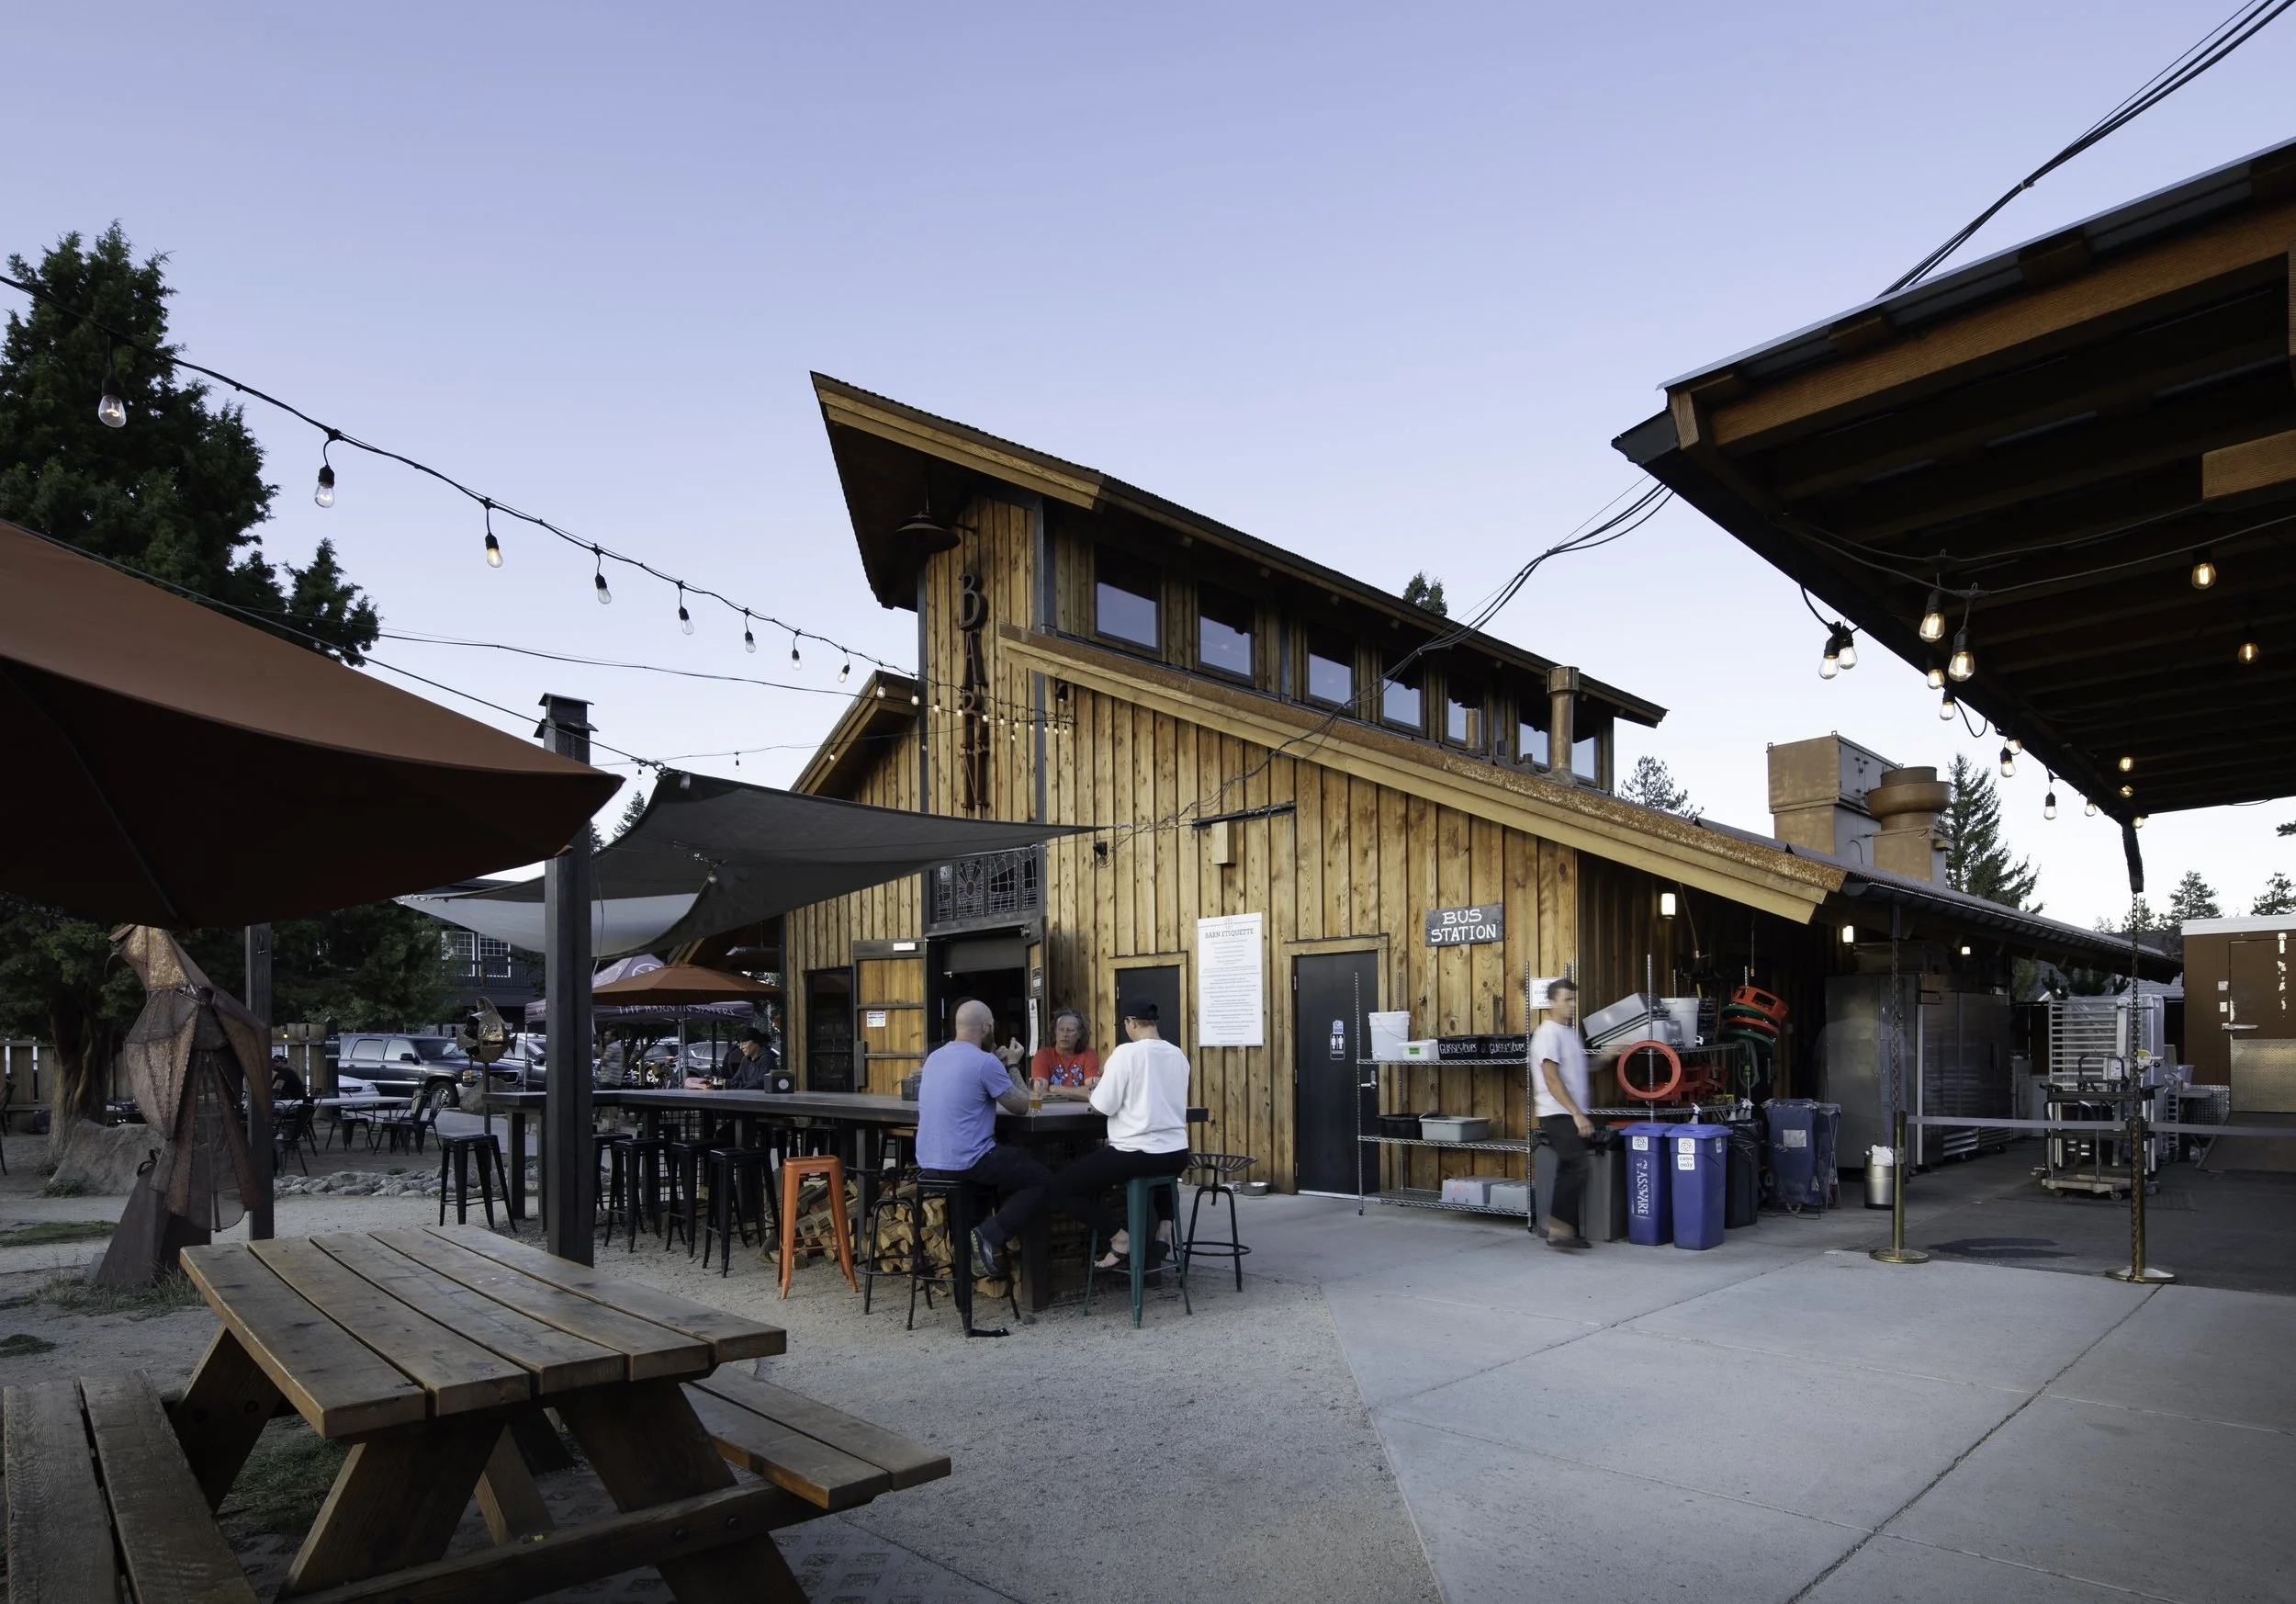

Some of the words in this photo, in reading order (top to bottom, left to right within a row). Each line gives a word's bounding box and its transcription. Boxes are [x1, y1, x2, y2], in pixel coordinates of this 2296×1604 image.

[958, 573, 989, 809] BARN
[1442, 909, 1482, 925] BUS
[1221, 928, 1255, 937] ETIQUETTE
[1431, 923, 1497, 943] STATION
[616, 1005, 640, 1014] THE
[645, 1005, 675, 1013] BARN
[695, 1006, 736, 1016] SISTERS
[1439, 1043, 1477, 1054] GLASSES/CUPS
[1490, 1042, 1525, 1054] GLASSES/CUPS
[1636, 1158, 1649, 1215] GLASSWARE
